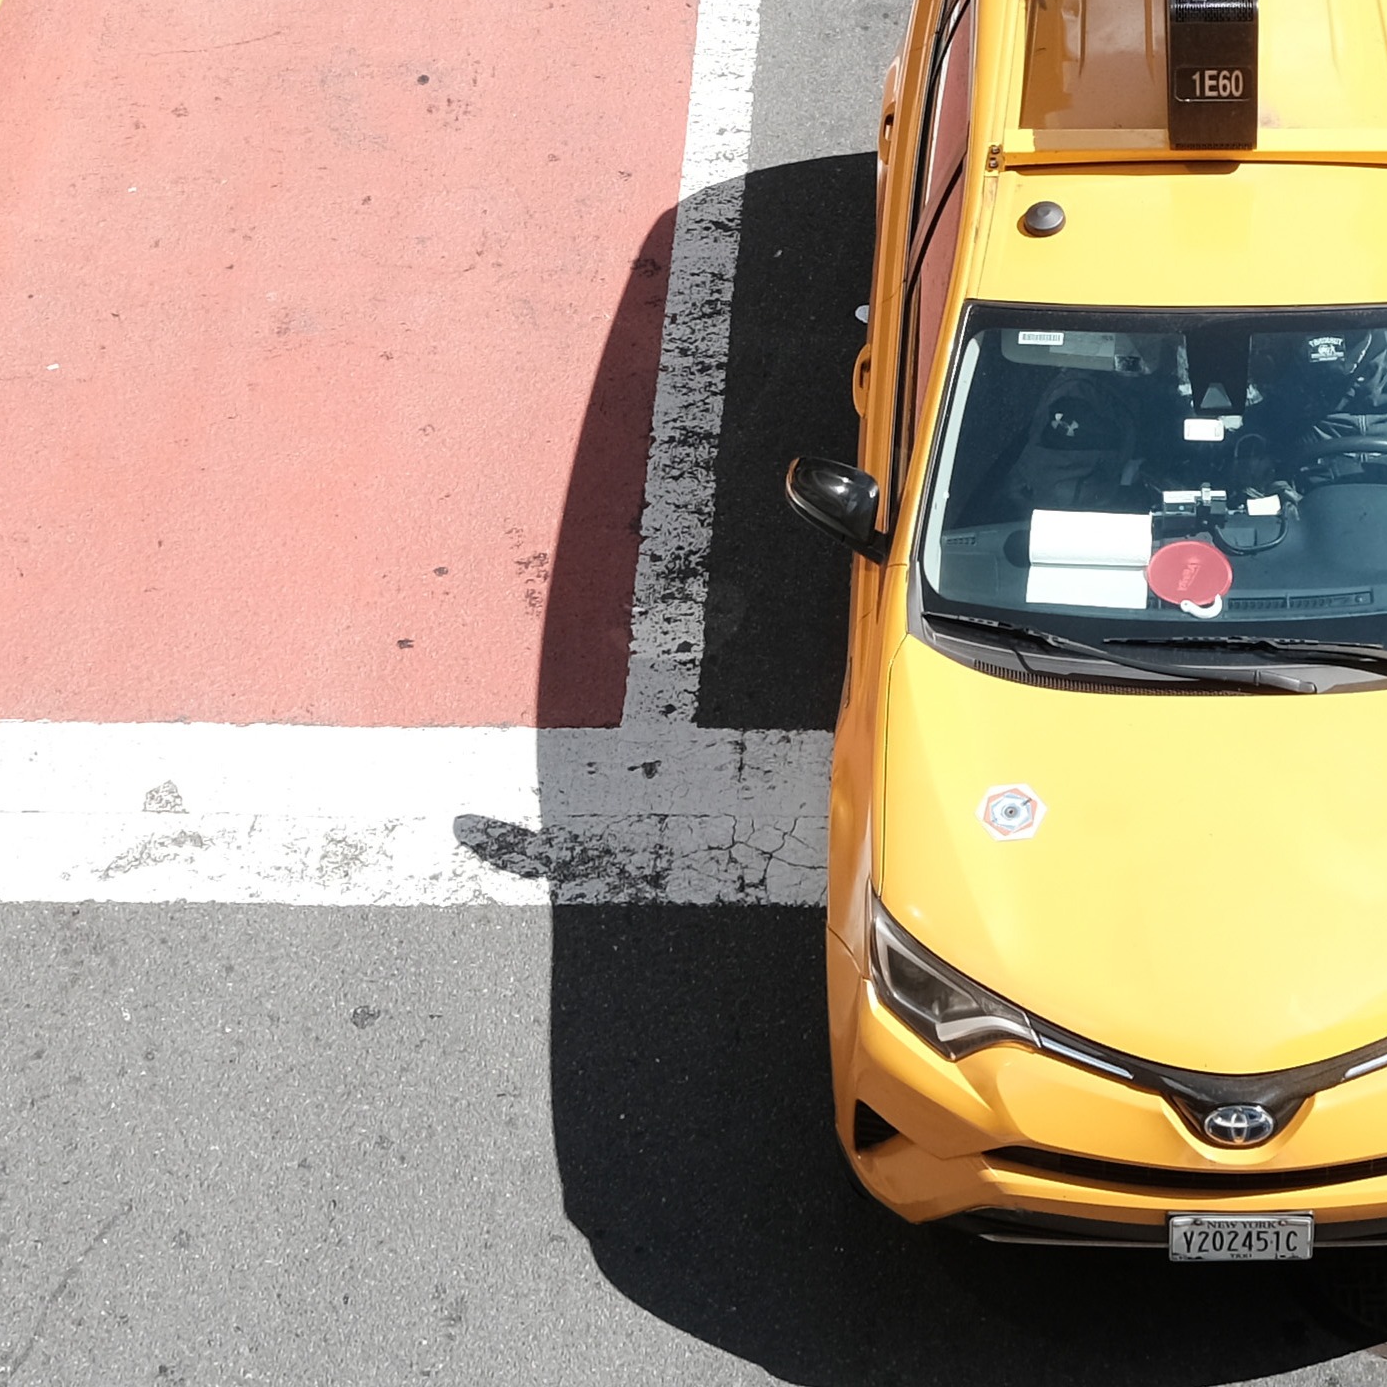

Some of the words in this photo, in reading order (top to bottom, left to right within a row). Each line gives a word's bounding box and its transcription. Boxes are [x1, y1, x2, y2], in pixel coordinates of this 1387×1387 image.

[1192, 70, 1244, 97] 1E60
[1207, 1220, 1237, 1229] NEW
[1241, 1220, 1277, 1229] YORK
[1183, 1230, 1299, 1253] Y202451C
